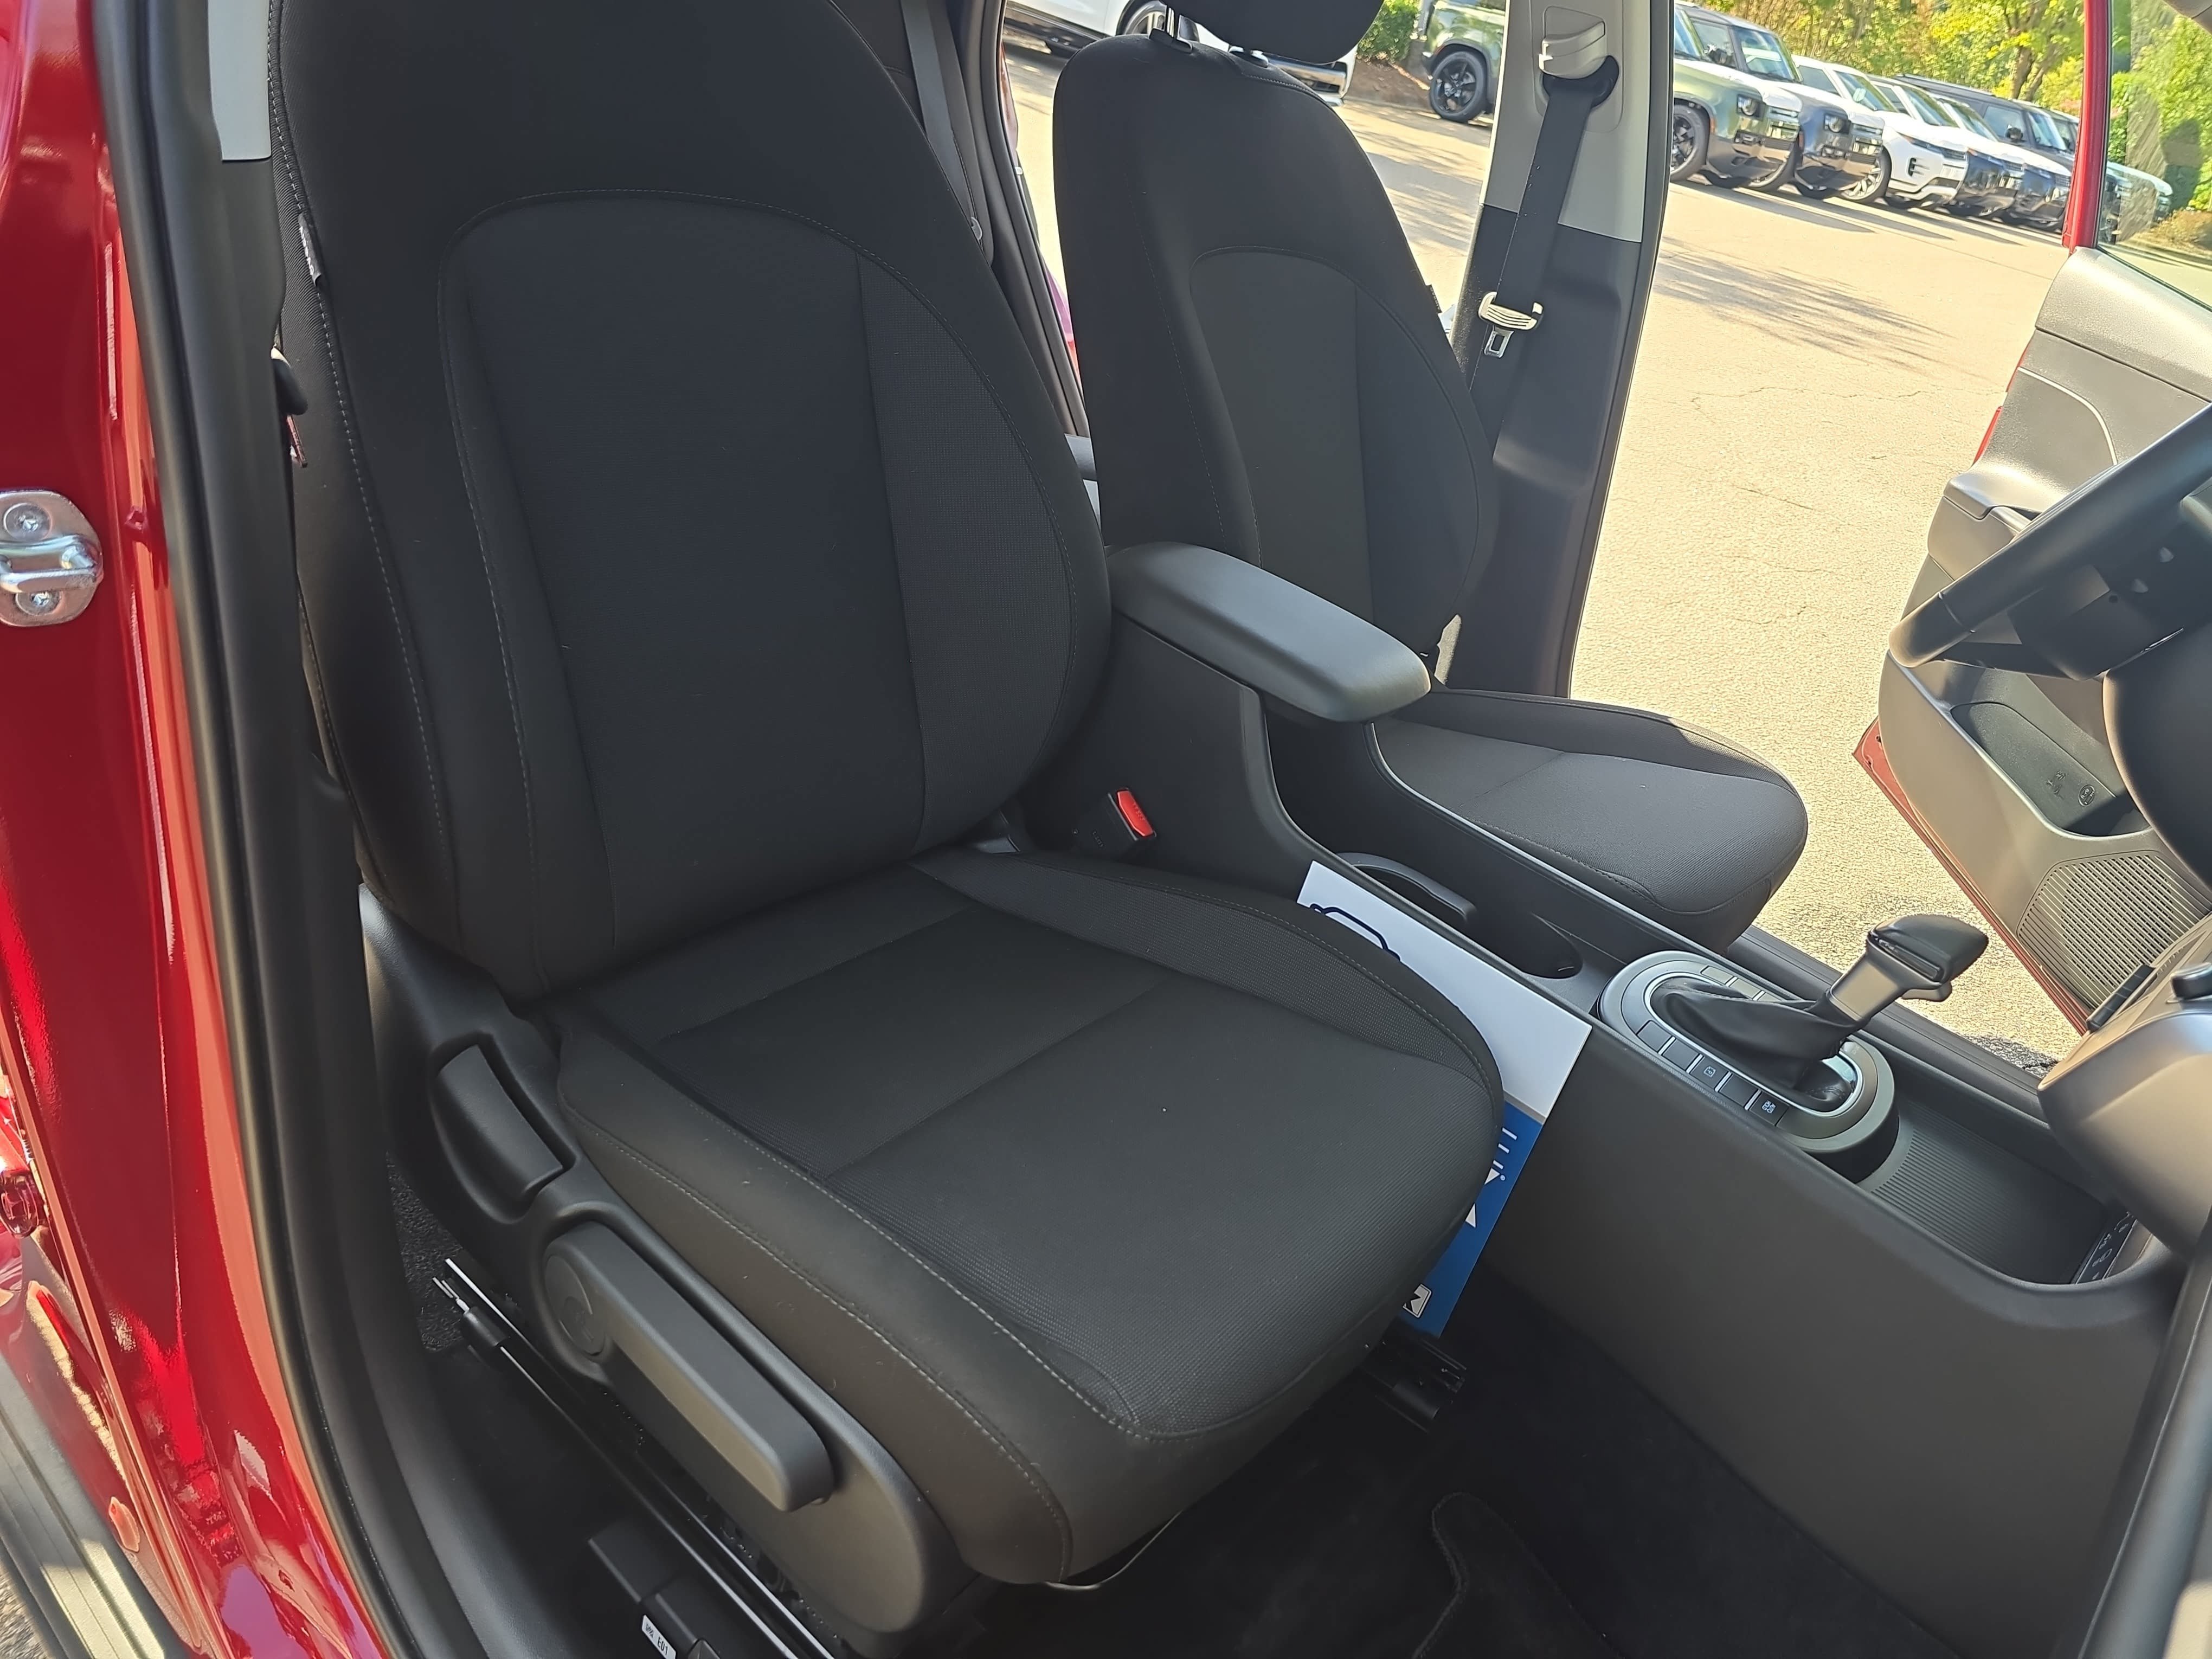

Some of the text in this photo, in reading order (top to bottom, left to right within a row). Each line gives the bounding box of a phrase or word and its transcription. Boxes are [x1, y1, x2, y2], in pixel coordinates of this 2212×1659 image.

[1761, 1100, 1772, 1110] HOLD
[1766, 1103, 1776, 1114] AUTO
[657, 1637, 668, 1656] E01
